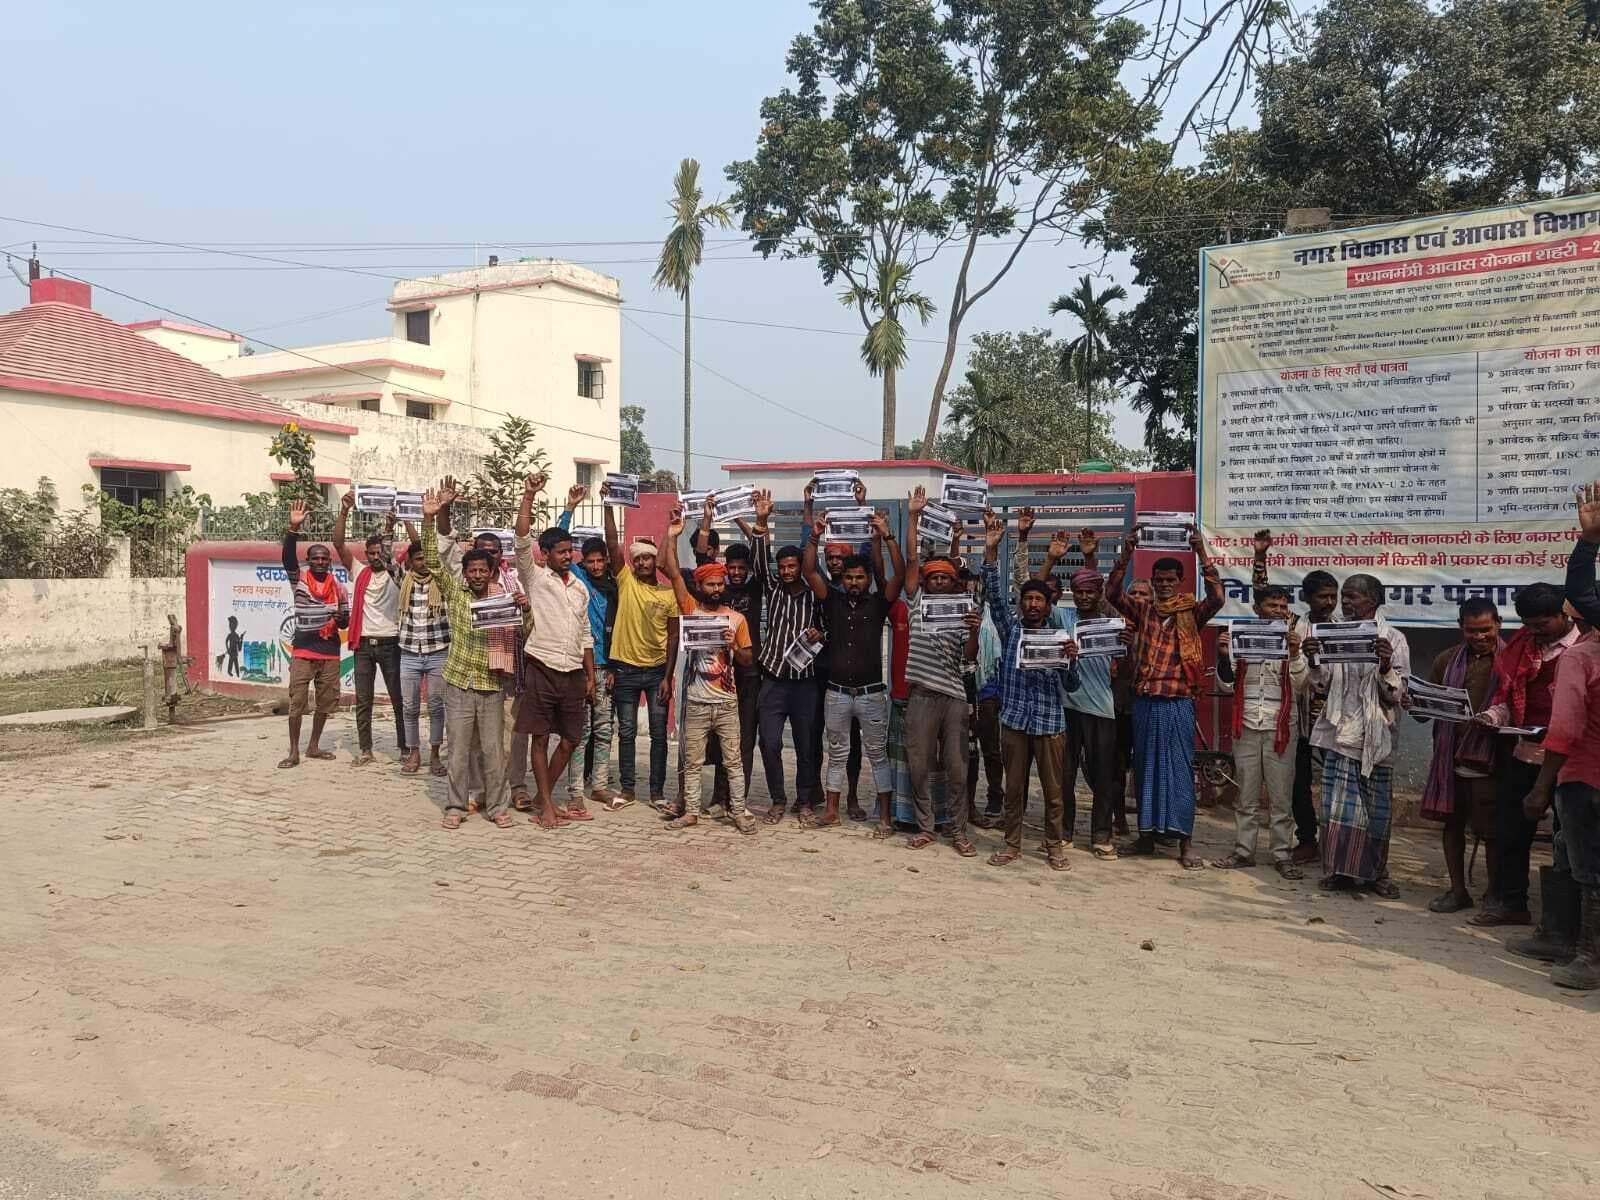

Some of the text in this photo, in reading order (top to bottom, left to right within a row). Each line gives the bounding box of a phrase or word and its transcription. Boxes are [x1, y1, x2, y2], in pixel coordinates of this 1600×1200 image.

[1294, 246, 1336, 265] नगर
[1340, 234, 1410, 261] विकास
[1415, 226, 1448, 250] एवं
[1452, 220, 1528, 246] आवास
[1353, 263, 1424, 284] प्रधानमंत्री
[1427, 258, 1477, 274] आवास
[1480, 250, 1531, 268] योजना
[1536, 242, 1578, 260] शहरी
[1267, 270, 1280, 280] 2.0
[1524, 348, 1561, 360] योजना
[1565, 347, 1580, 357] का
[1280, 369, 1308, 380] योजना
[1312, 368, 1320, 377] के
[1324, 366, 1341, 377] लिए
[1380, 361, 1408, 373] पात्रता
[1572, 484, 1584, 493] (S
[1563, 502, 1577, 511] (ल
[1350, 510, 1404, 519] Undertaking
[1302, 535, 1343, 546] आवास
[1345, 532, 1358, 546] से
[1412, 530, 1471, 545] जानकारी
[1475, 531, 1490, 544] के
[1494, 530, 1522, 545] लिए
[1525, 532, 1561, 543] नगर
[1288, 556, 1329, 567] आवास
[1332, 553, 1374, 567] योजना
[1377, 552, 1389, 566] में
[1391, 552, 1427, 567] किसी
[1430, 552, 1446, 566] भी
[1450, 553, 1489, 566] प्रकार
[1491, 553, 1512, 565] का
[1515, 550, 1546, 567] कोई
[256, 566, 289, 581] स्वच्छ
[1381, 585, 1435, 606] गर
